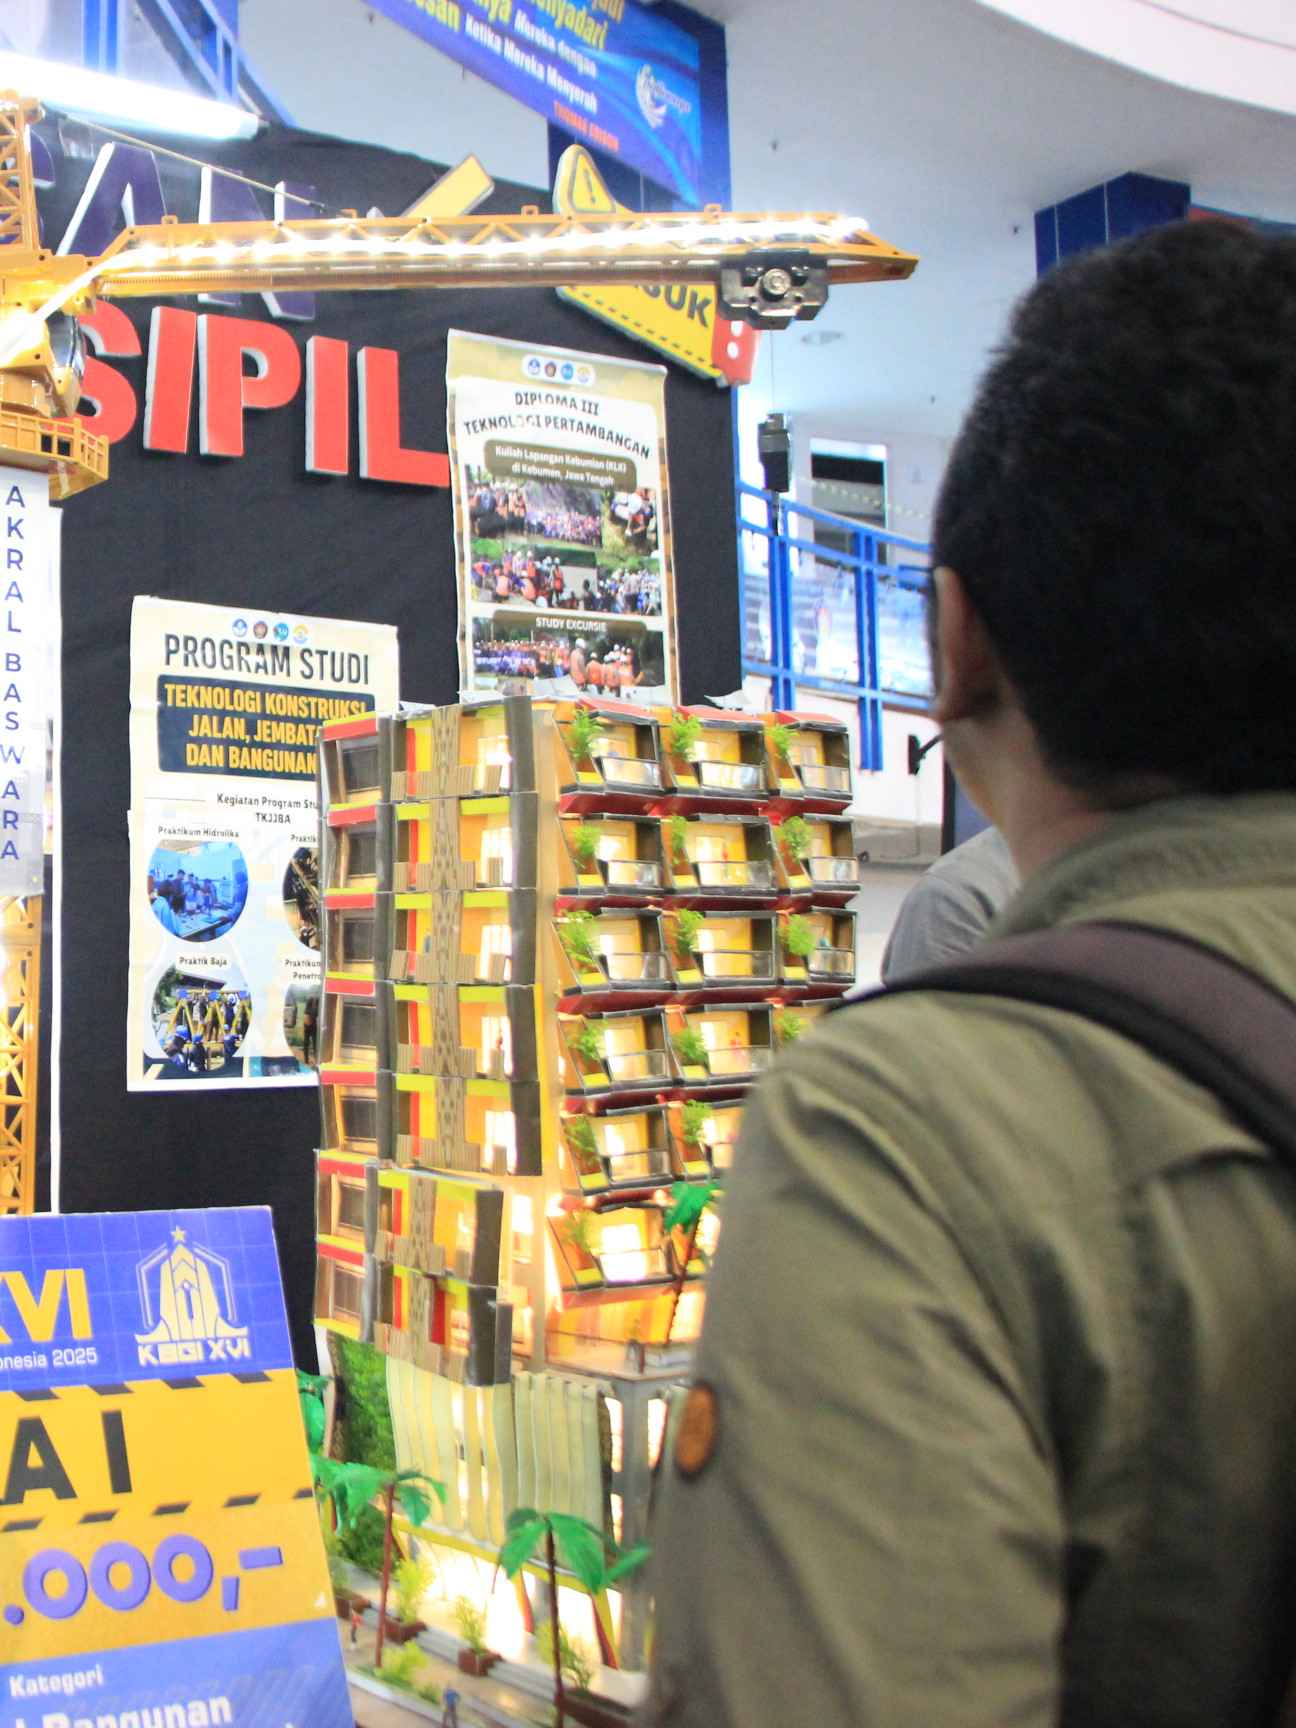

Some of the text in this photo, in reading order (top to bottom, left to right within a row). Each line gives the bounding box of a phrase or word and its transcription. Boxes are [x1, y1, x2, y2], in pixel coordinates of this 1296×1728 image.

[514, 9, 555, 51] Mereka
[557, 39, 597, 78] dengan
[465, 12, 502, 56] Ketika
[504, 37, 545, 82] Mereka
[547, 64, 597, 115] Menyerah
[554, 101, 620, 152] THOMAS EDISON
[76, 299, 450, 488] SIPIL
[515, 391, 600, 416] DIPLOMA III
[463, 414, 650, 459] TEKNOLOGI PERTAMBANGAN
[495, 445, 627, 473] Kuliah Lapangan Kebumian (KLK)
[512, 462, 614, 487] di Kebumen, Jawa Tengah
[5, 485, 26, 633] AKRAL
[535, 617, 565, 630] STUDY
[164, 633, 369, 685] PROGRAM STUDI
[164, 683, 366, 720] TEKNOLOGI KONSTRUKSI
[188, 714, 320, 746] JALAN, JEMBAT
[186, 743, 317, 775] DAN BANGUNAN
[217, 793, 318, 810] Kegiatan Program Stu
[158, 826, 239, 838] Praktikum Hidrolika
[255, 812, 291, 824] TKJJBA
[290, 834, 317, 843] Praktik
[179, 955, 227, 968] Praktik Baja
[292, 971, 321, 981] Penetro
[52, 1347, 98, 1366] 2025
[137, 1337, 252, 1366] KBGI XVI
[101, 1409, 134, 1495] I
[9, 1663, 104, 1699] Kategori
